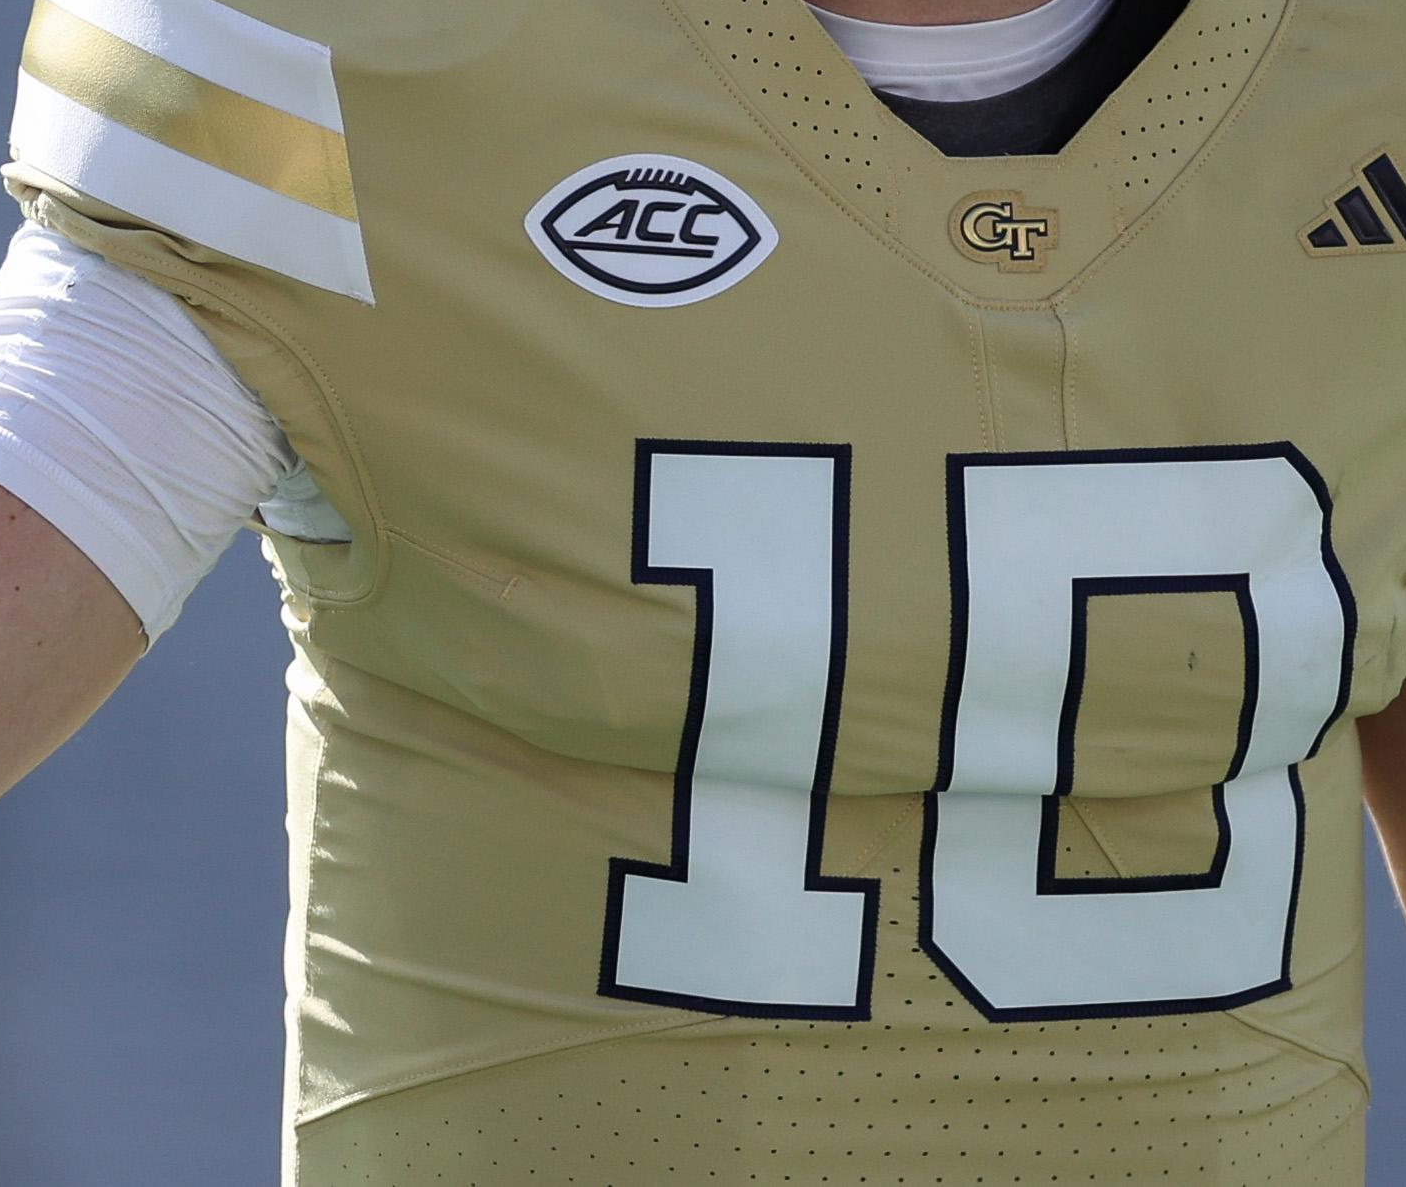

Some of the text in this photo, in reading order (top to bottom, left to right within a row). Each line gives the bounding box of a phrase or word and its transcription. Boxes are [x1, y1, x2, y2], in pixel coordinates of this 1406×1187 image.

[573, 199, 727, 246] ACC
[960, 202, 1048, 260] GT
[597, 438, 1357, 1022] 10
